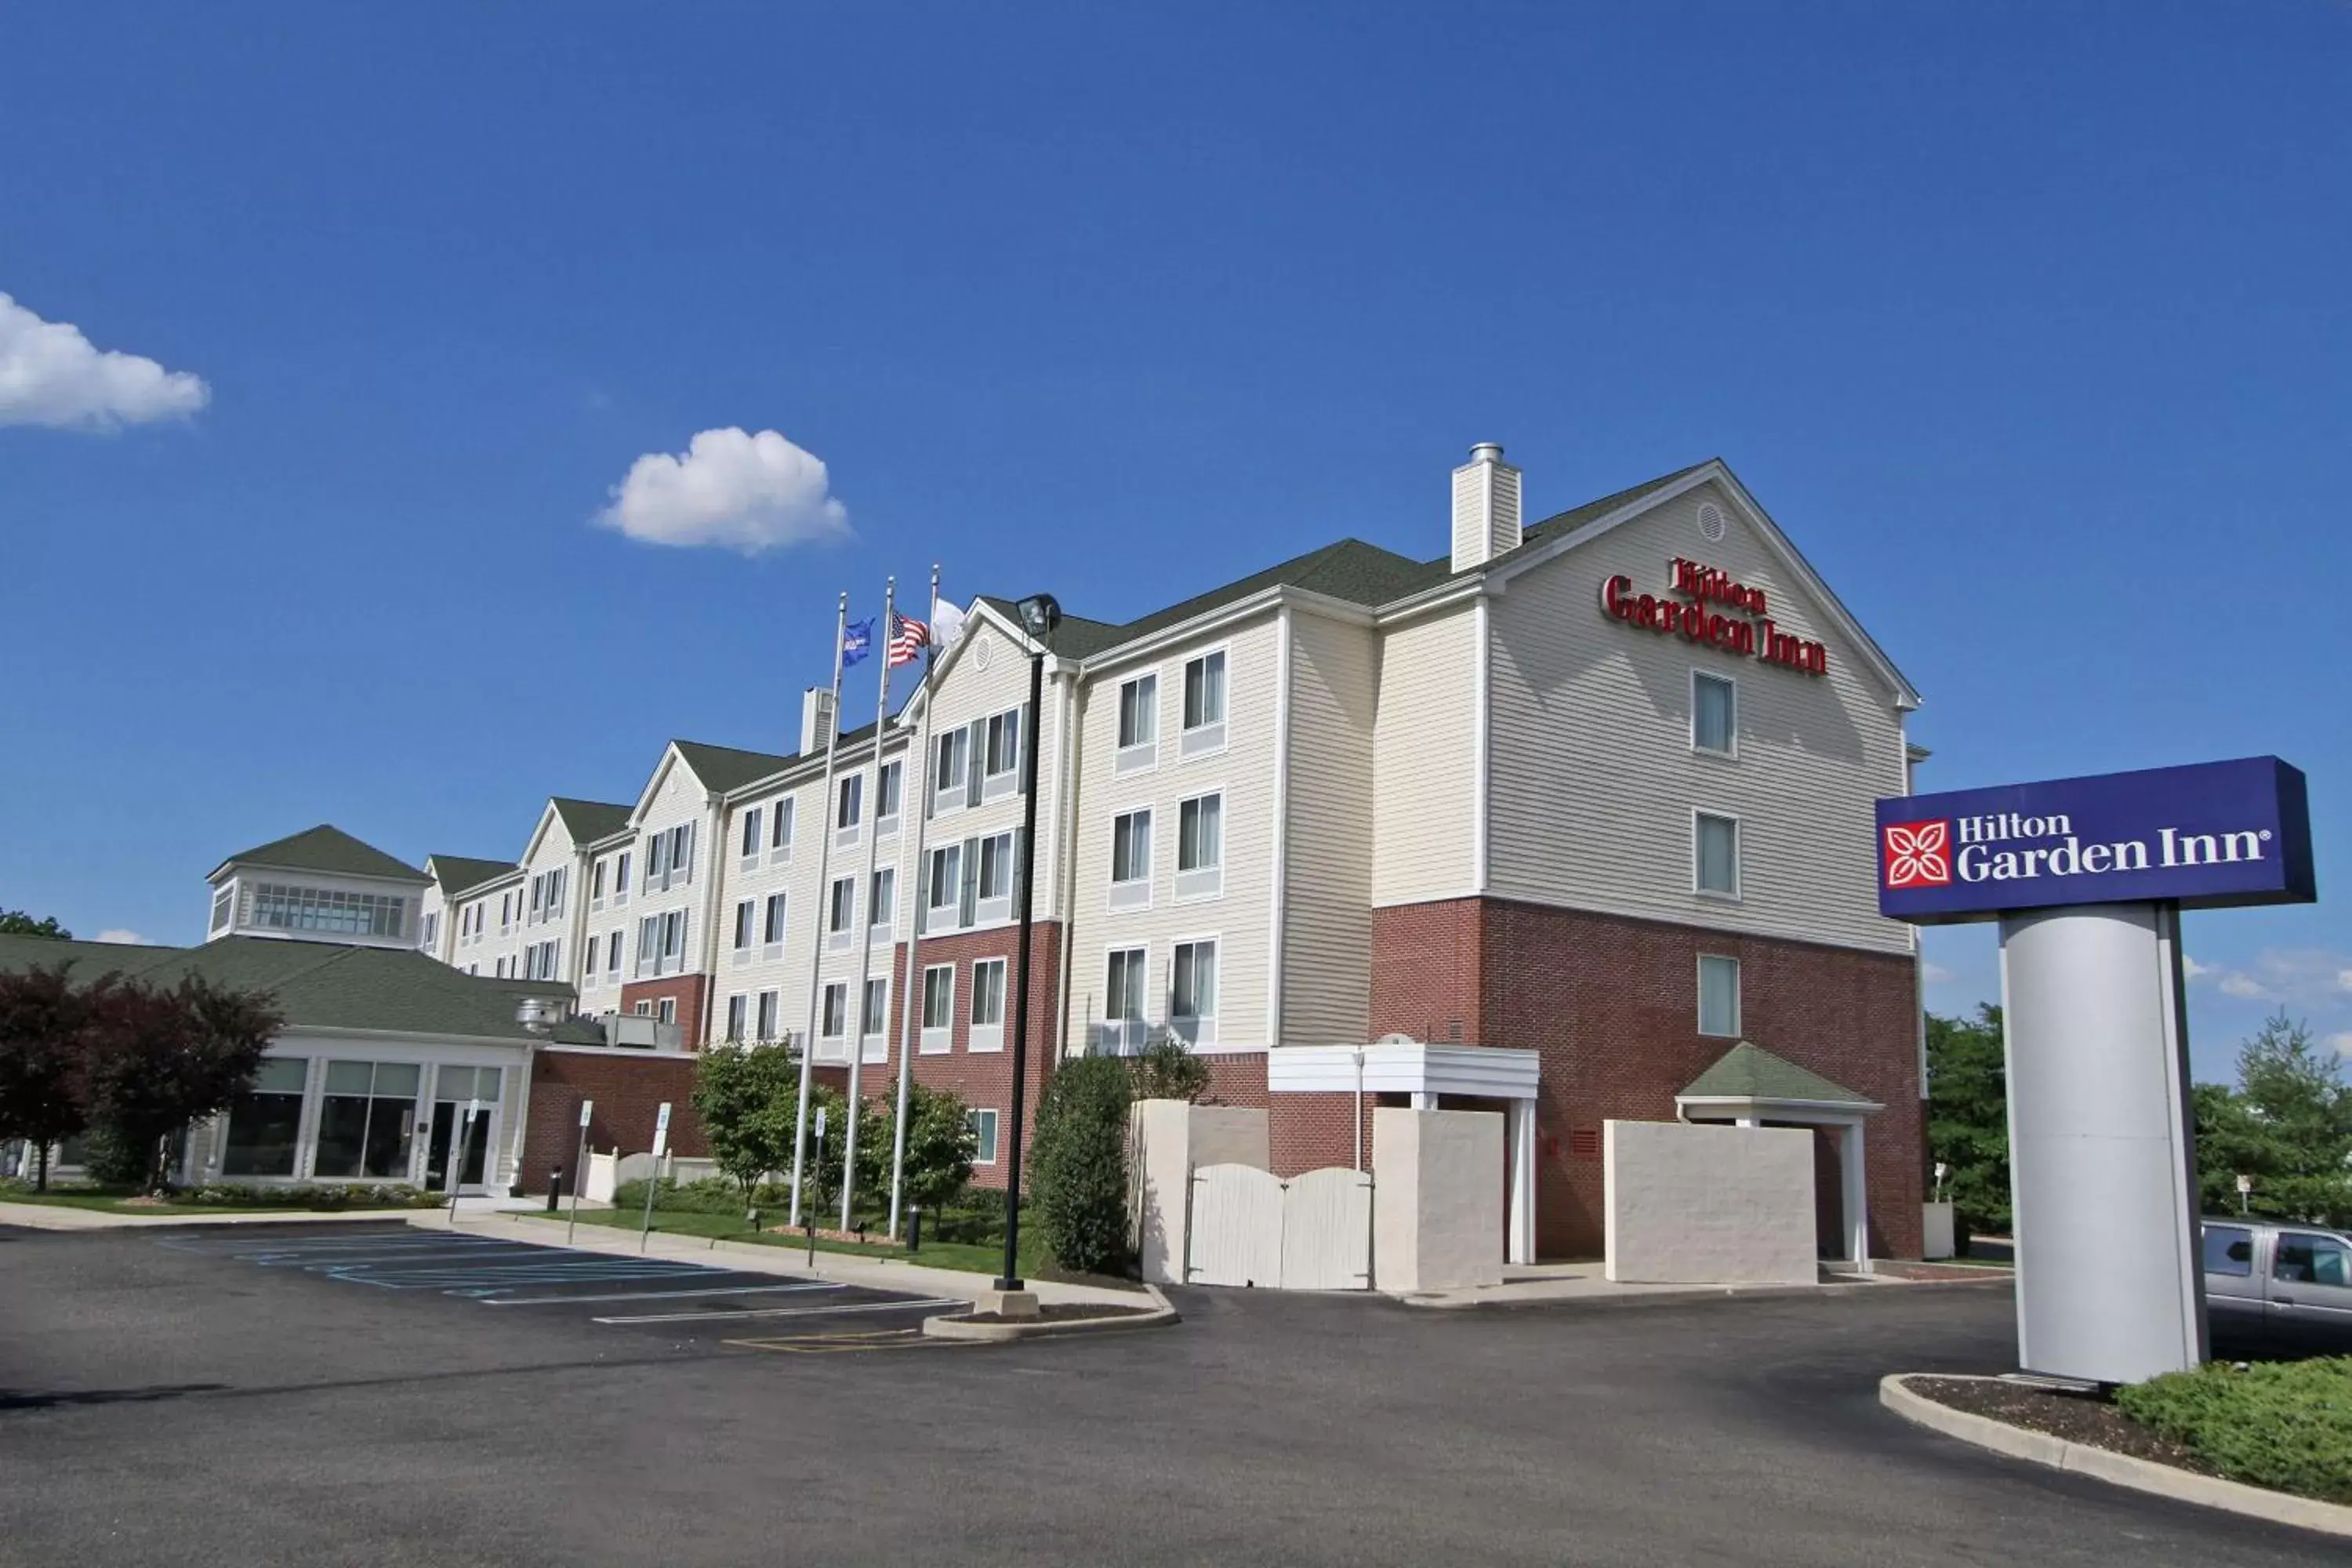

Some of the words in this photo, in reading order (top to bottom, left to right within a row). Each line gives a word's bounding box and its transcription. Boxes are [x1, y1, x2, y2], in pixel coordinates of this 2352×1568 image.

[1668, 556, 1767, 615] Hilton
[1600, 575, 1755, 655] Garden
[1757, 618, 1828, 675] Inn
[1958, 812, 2071, 844] Hilton
[1958, 837, 2151, 882] Garden
